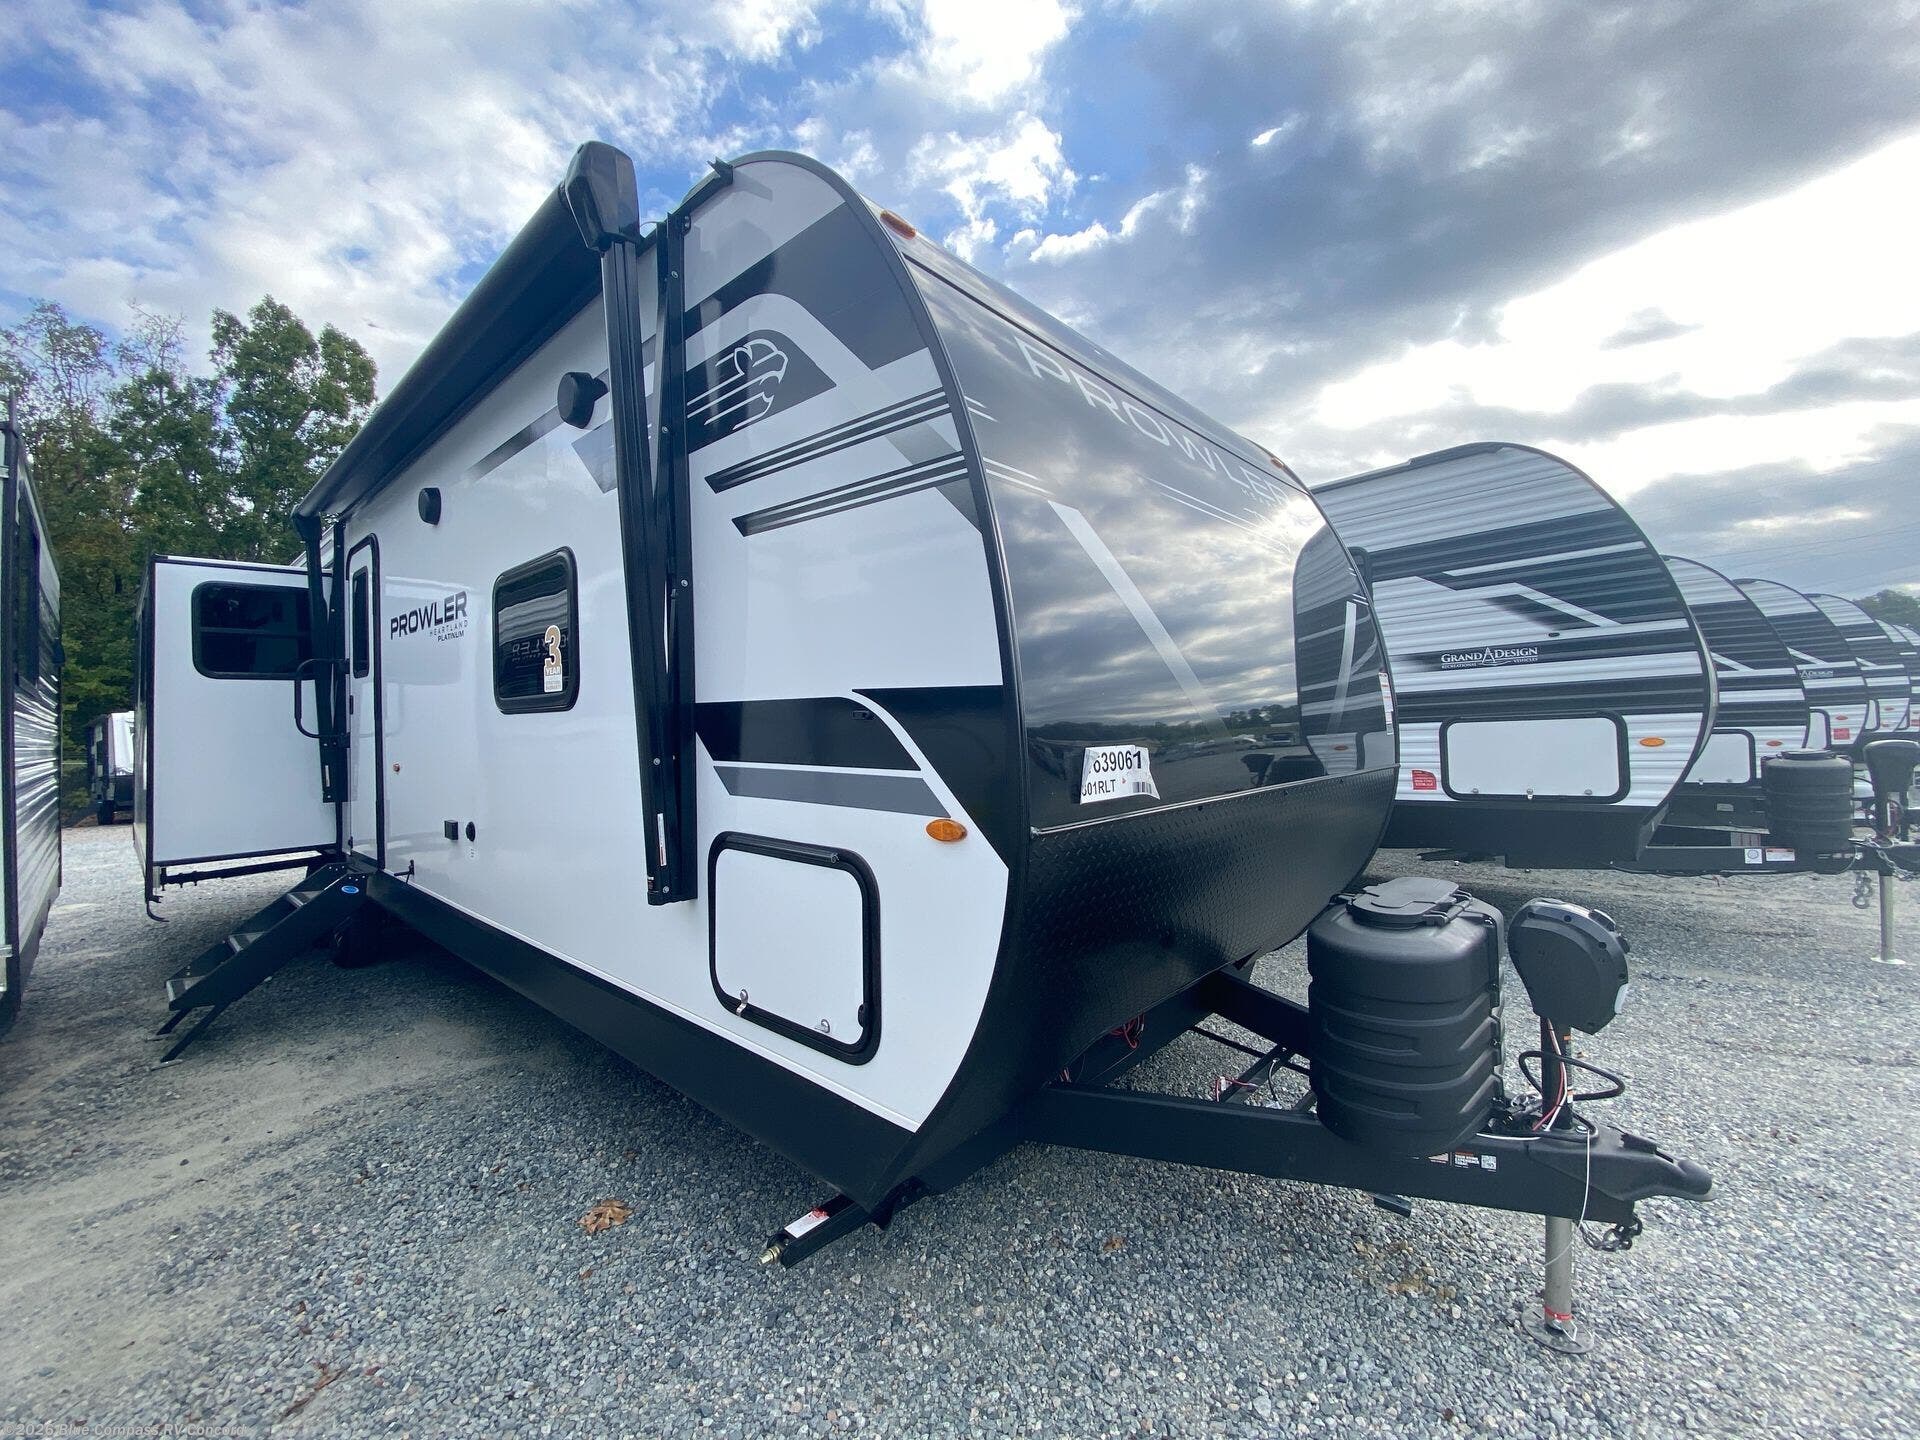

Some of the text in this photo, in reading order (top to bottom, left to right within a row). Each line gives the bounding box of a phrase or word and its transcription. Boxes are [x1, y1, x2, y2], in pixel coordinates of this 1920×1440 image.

[1014, 335, 1289, 506] PROWLER
[390, 590, 467, 641] PROWLER
[429, 619, 469, 637] HEARTLAND
[437, 630, 465, 642] PLATINUM
[545, 625, 561, 666] 3
[1441, 647, 1538, 663] GRAND DESIGN
[1089, 750, 1142, 774] 639061
